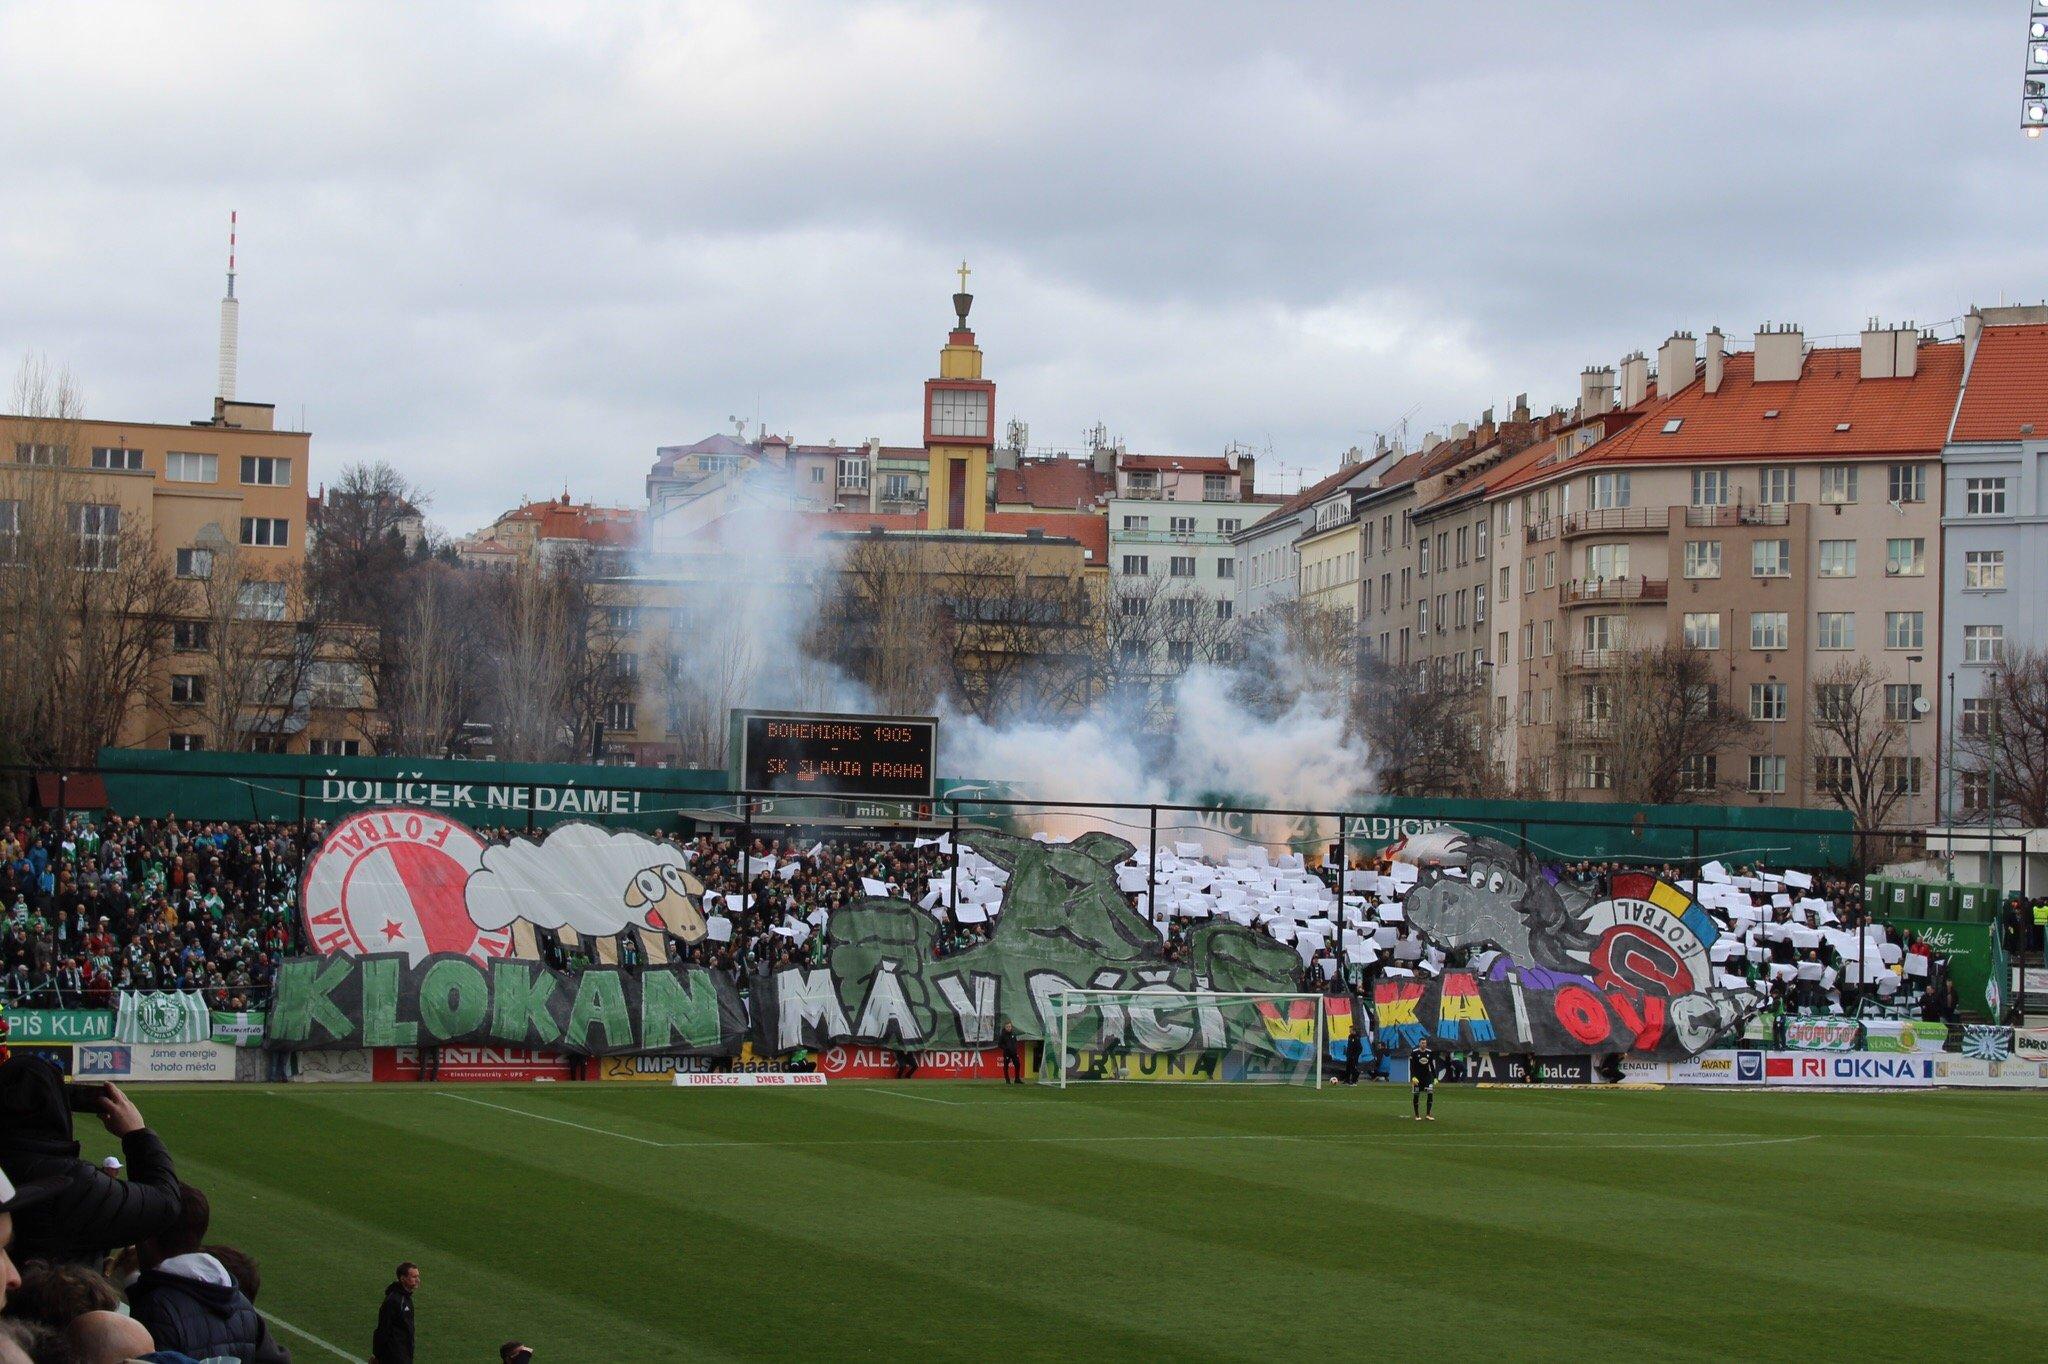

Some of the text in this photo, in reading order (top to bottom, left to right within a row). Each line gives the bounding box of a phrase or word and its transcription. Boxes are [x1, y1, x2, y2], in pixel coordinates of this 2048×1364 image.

[768, 722, 912, 742] BOHEMIANS 1905
[767, 758, 923, 779] SK SLAVIA PRAHA
[487, 779, 641, 814] NEDÁME!
[328, 814, 453, 858] FOTBAL
[1617, 901, 1697, 954] FOTBAL
[270, 958, 722, 1049] KLOKAN
[777, 961, 923, 1050] MÁ
[935, 974, 999, 1044] V
[1252, 971, 1497, 1062] VLKA
[52, 1015, 108, 1036] KLAN
[151, 1049, 218, 1061] Jsme energie
[635, 1056, 711, 1074] IMPULS
[1701, 1060, 1731, 1069] AVANT
[150, 1062, 182, 1072] tohoto
[1802, 1058, 1915, 1078] RI OKNA
[689, 1074, 822, 1085] iDNES.cz DNES DNES
